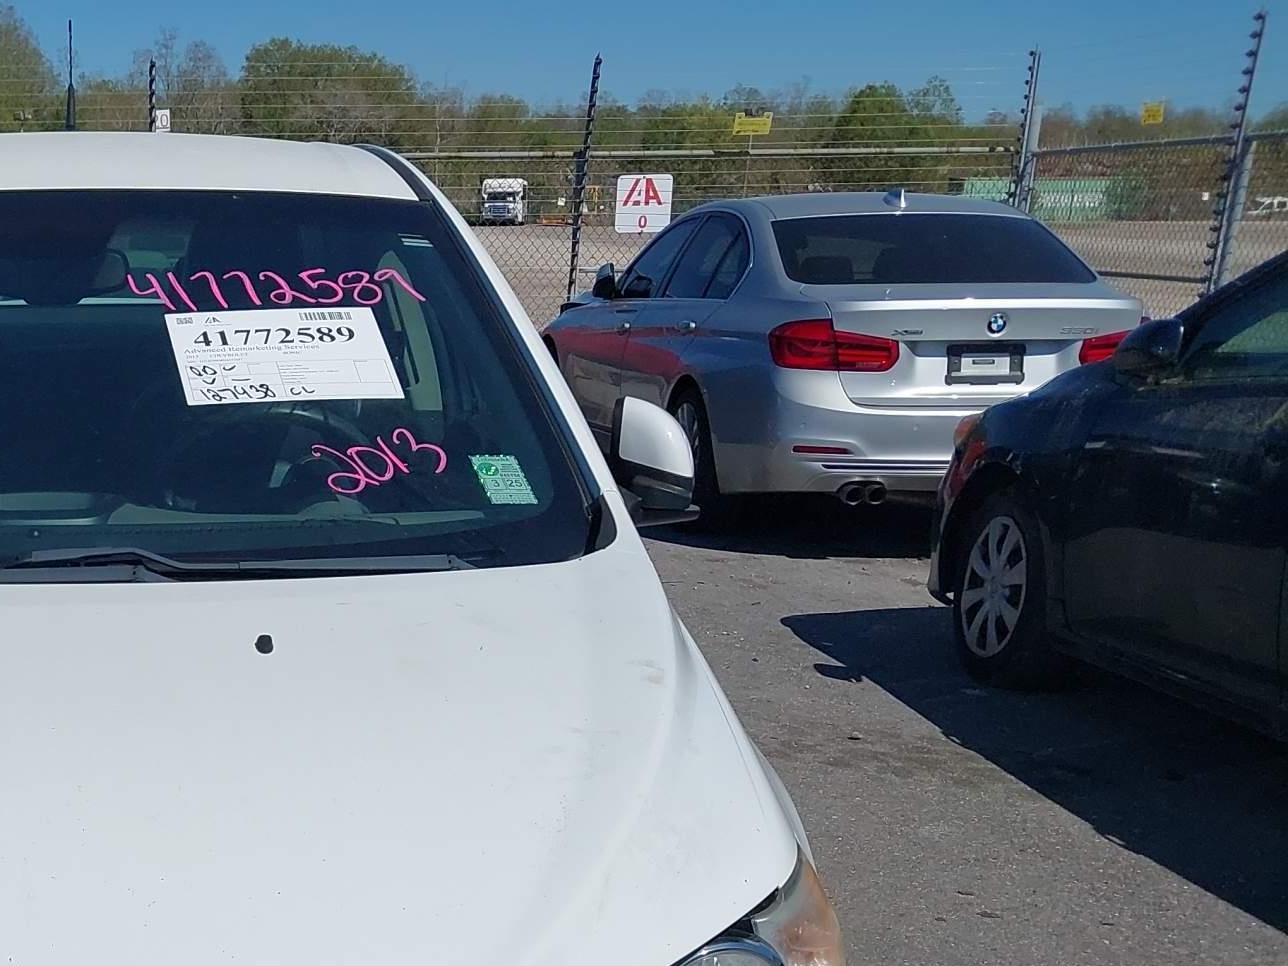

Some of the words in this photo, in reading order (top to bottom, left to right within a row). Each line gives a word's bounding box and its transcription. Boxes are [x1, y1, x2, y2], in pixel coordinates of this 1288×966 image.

[638, 215, 648, 228] 0
[127, 268, 426, 311] 41772589
[193, 326, 355, 346] 41772589
[184, 346, 226, 354] Advanced
[228, 345, 282, 353] Remarketing
[311, 428, 447, 494] 2013
